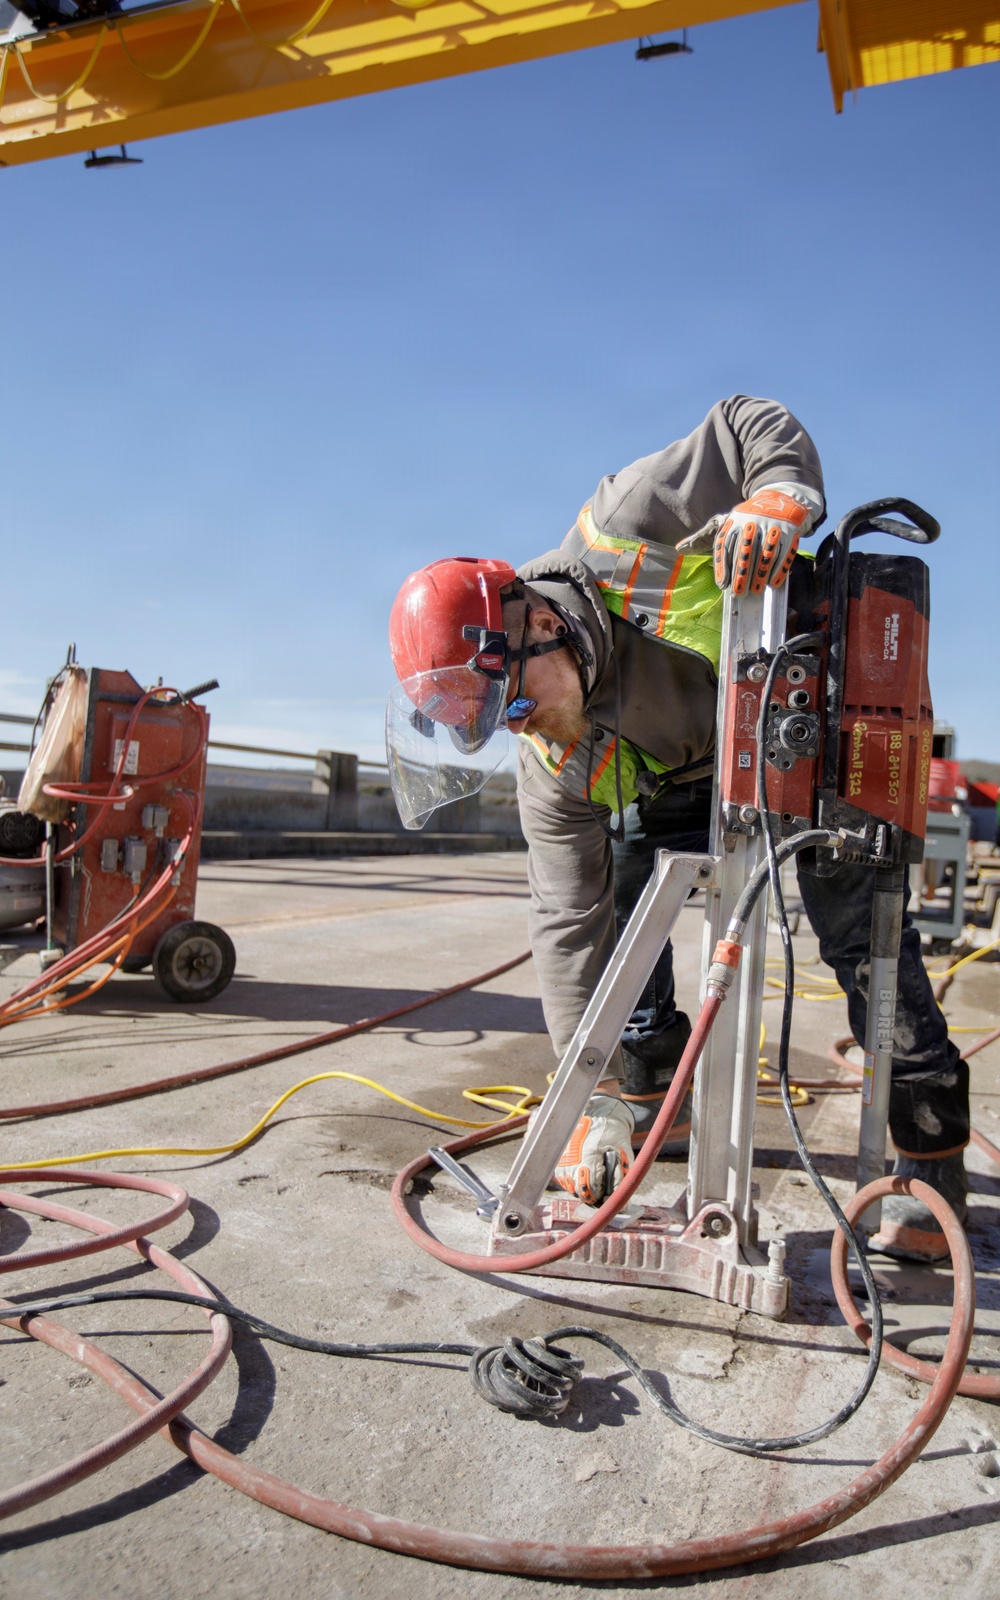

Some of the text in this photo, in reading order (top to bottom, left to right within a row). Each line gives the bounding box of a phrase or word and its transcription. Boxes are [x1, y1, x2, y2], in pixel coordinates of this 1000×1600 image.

[885, 617, 890, 628] DD
[890, 613, 899, 660] HILTI
[852, 722, 867, 768] Penhall
[877, 989, 892, 1038] BORE
